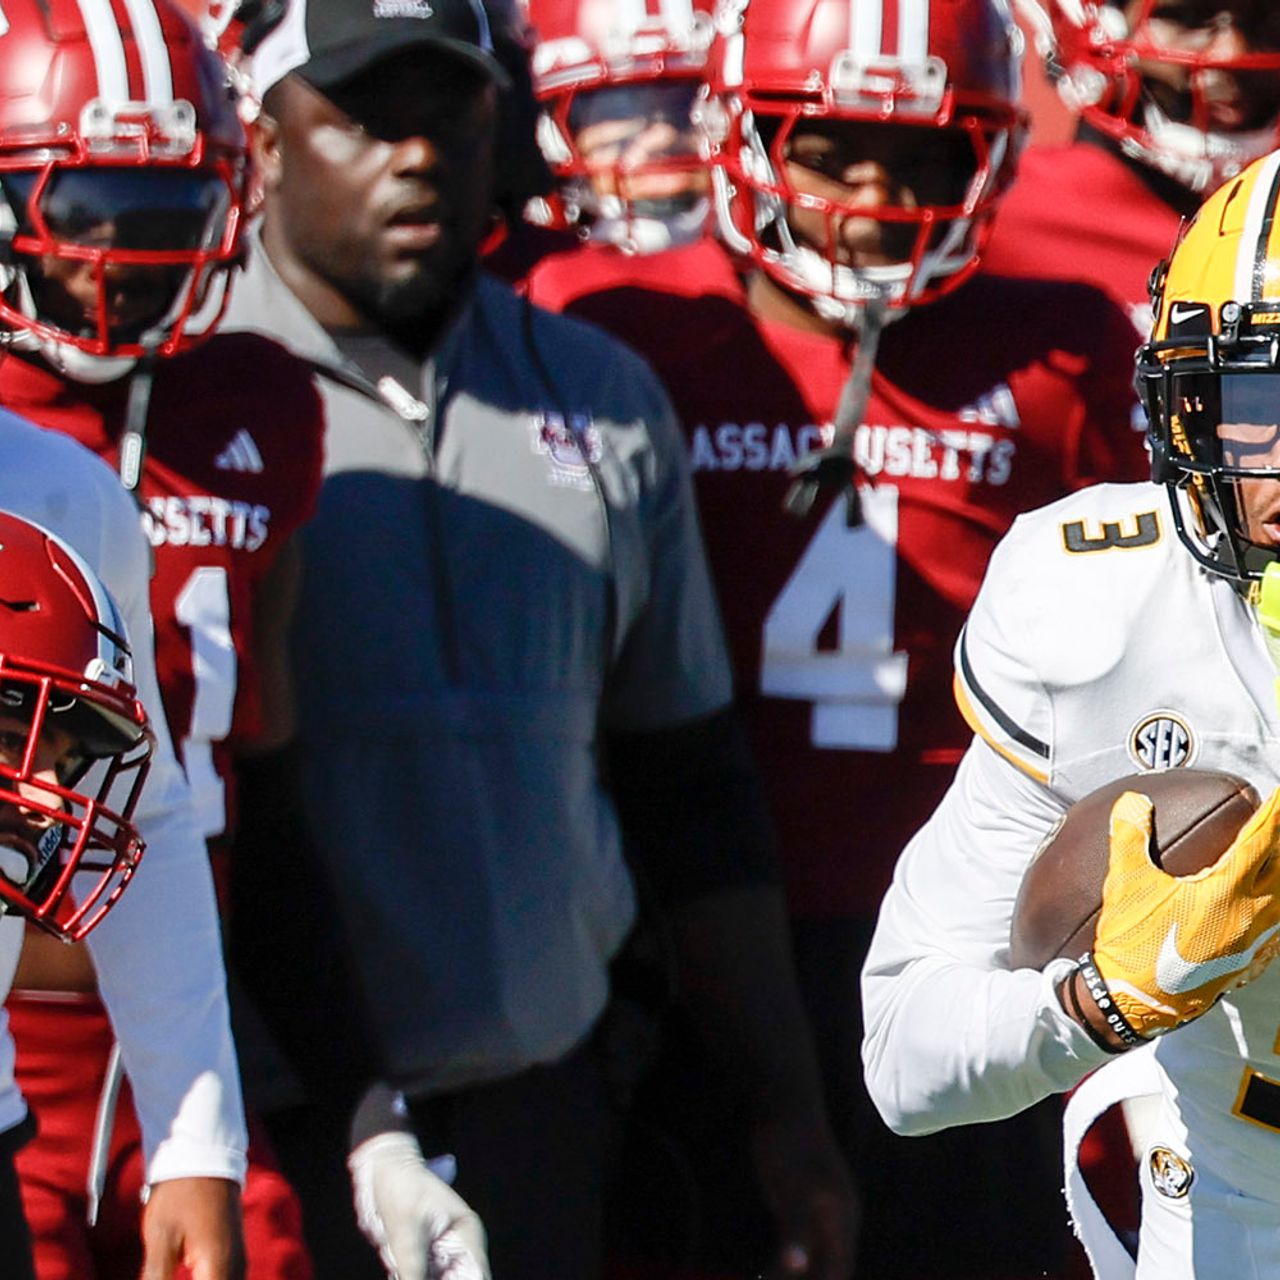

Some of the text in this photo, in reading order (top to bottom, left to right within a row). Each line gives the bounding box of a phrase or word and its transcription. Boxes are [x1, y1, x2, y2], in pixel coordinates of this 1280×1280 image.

[1059, 508, 1164, 557] 3
[760, 482, 910, 753] 4
[1135, 719, 1190, 769] SEC
